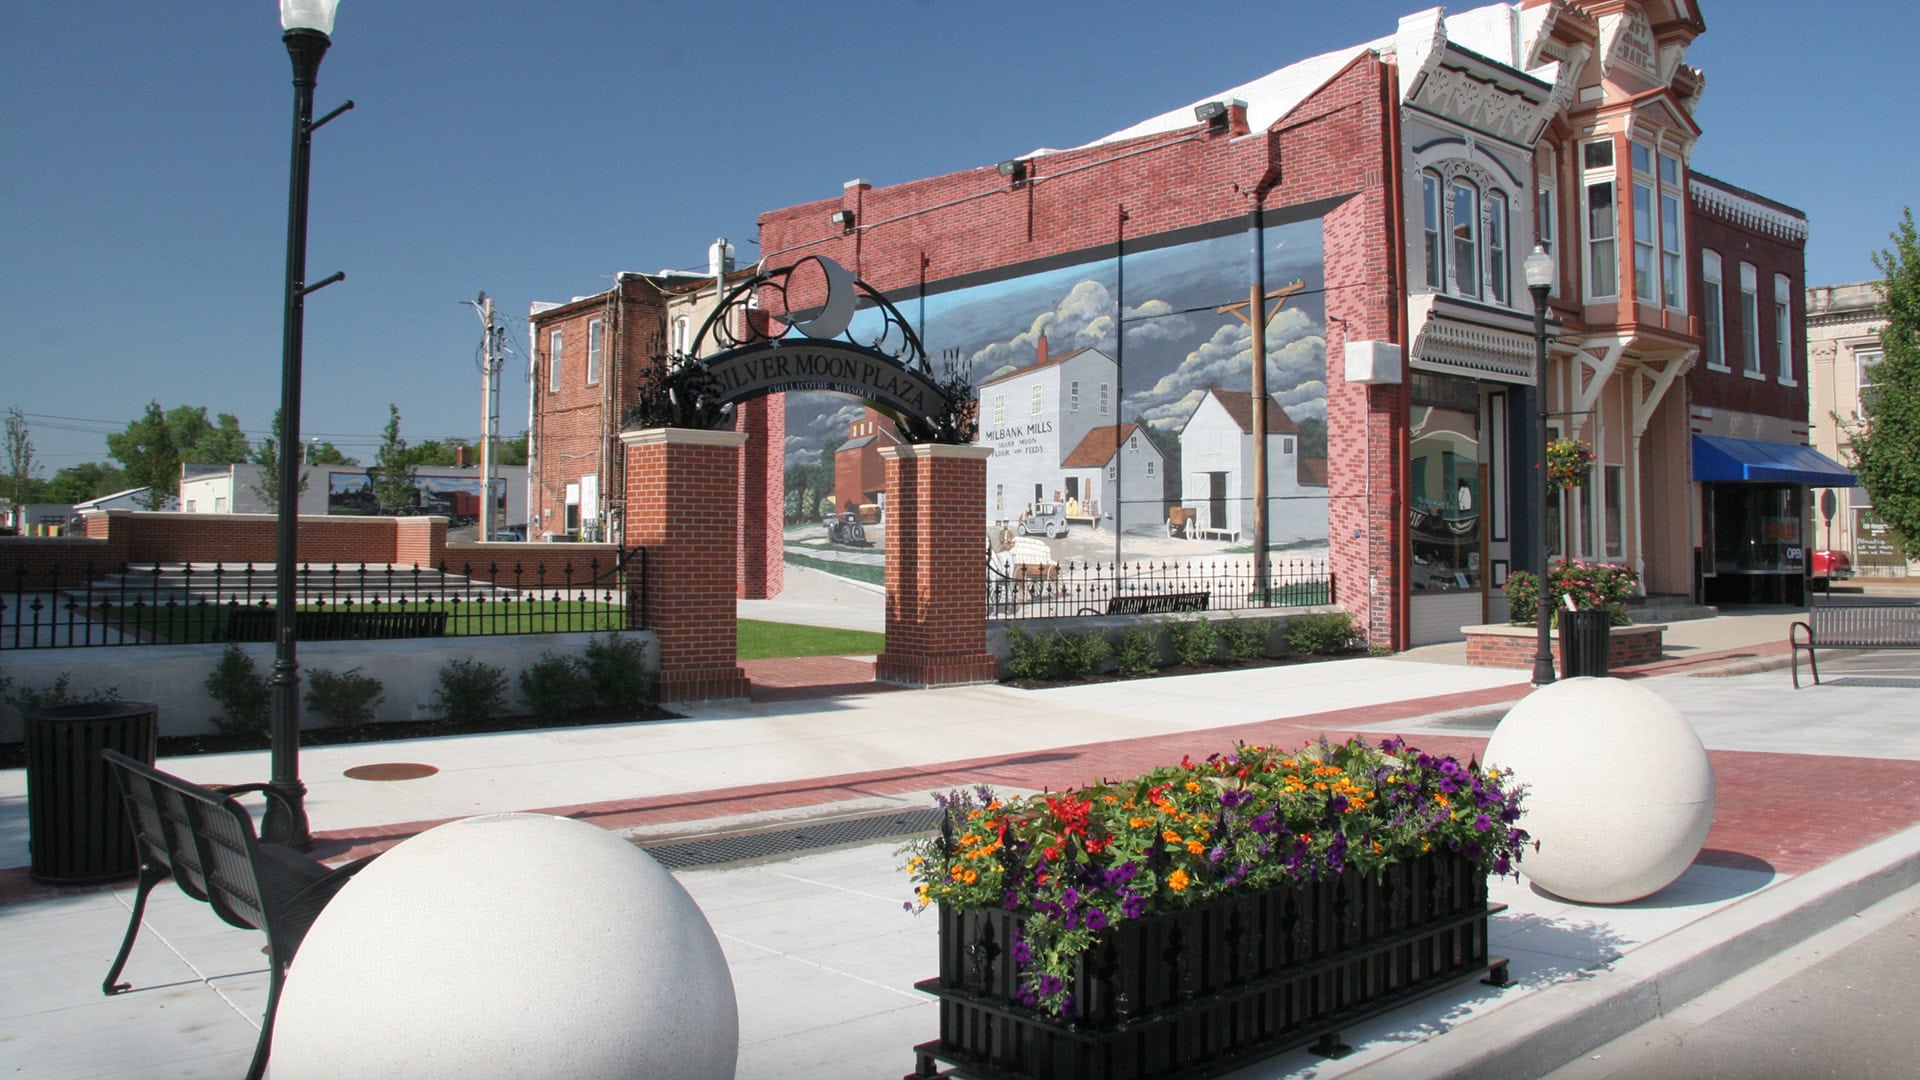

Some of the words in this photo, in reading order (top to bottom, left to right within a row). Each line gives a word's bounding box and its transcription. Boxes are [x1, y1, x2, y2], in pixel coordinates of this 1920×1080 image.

[714, 355, 790, 393] SILVER
[795, 354, 857, 378] MOON
[863, 364, 924, 410] PLAZA
[833, 383, 878, 401] MISSOURI
[986, 427, 1023, 440] MILBANK
[1027, 421, 1052, 435] MILLS
[1019, 437, 1037, 446] MOON
[1025, 446, 1043, 454] FEEDS
